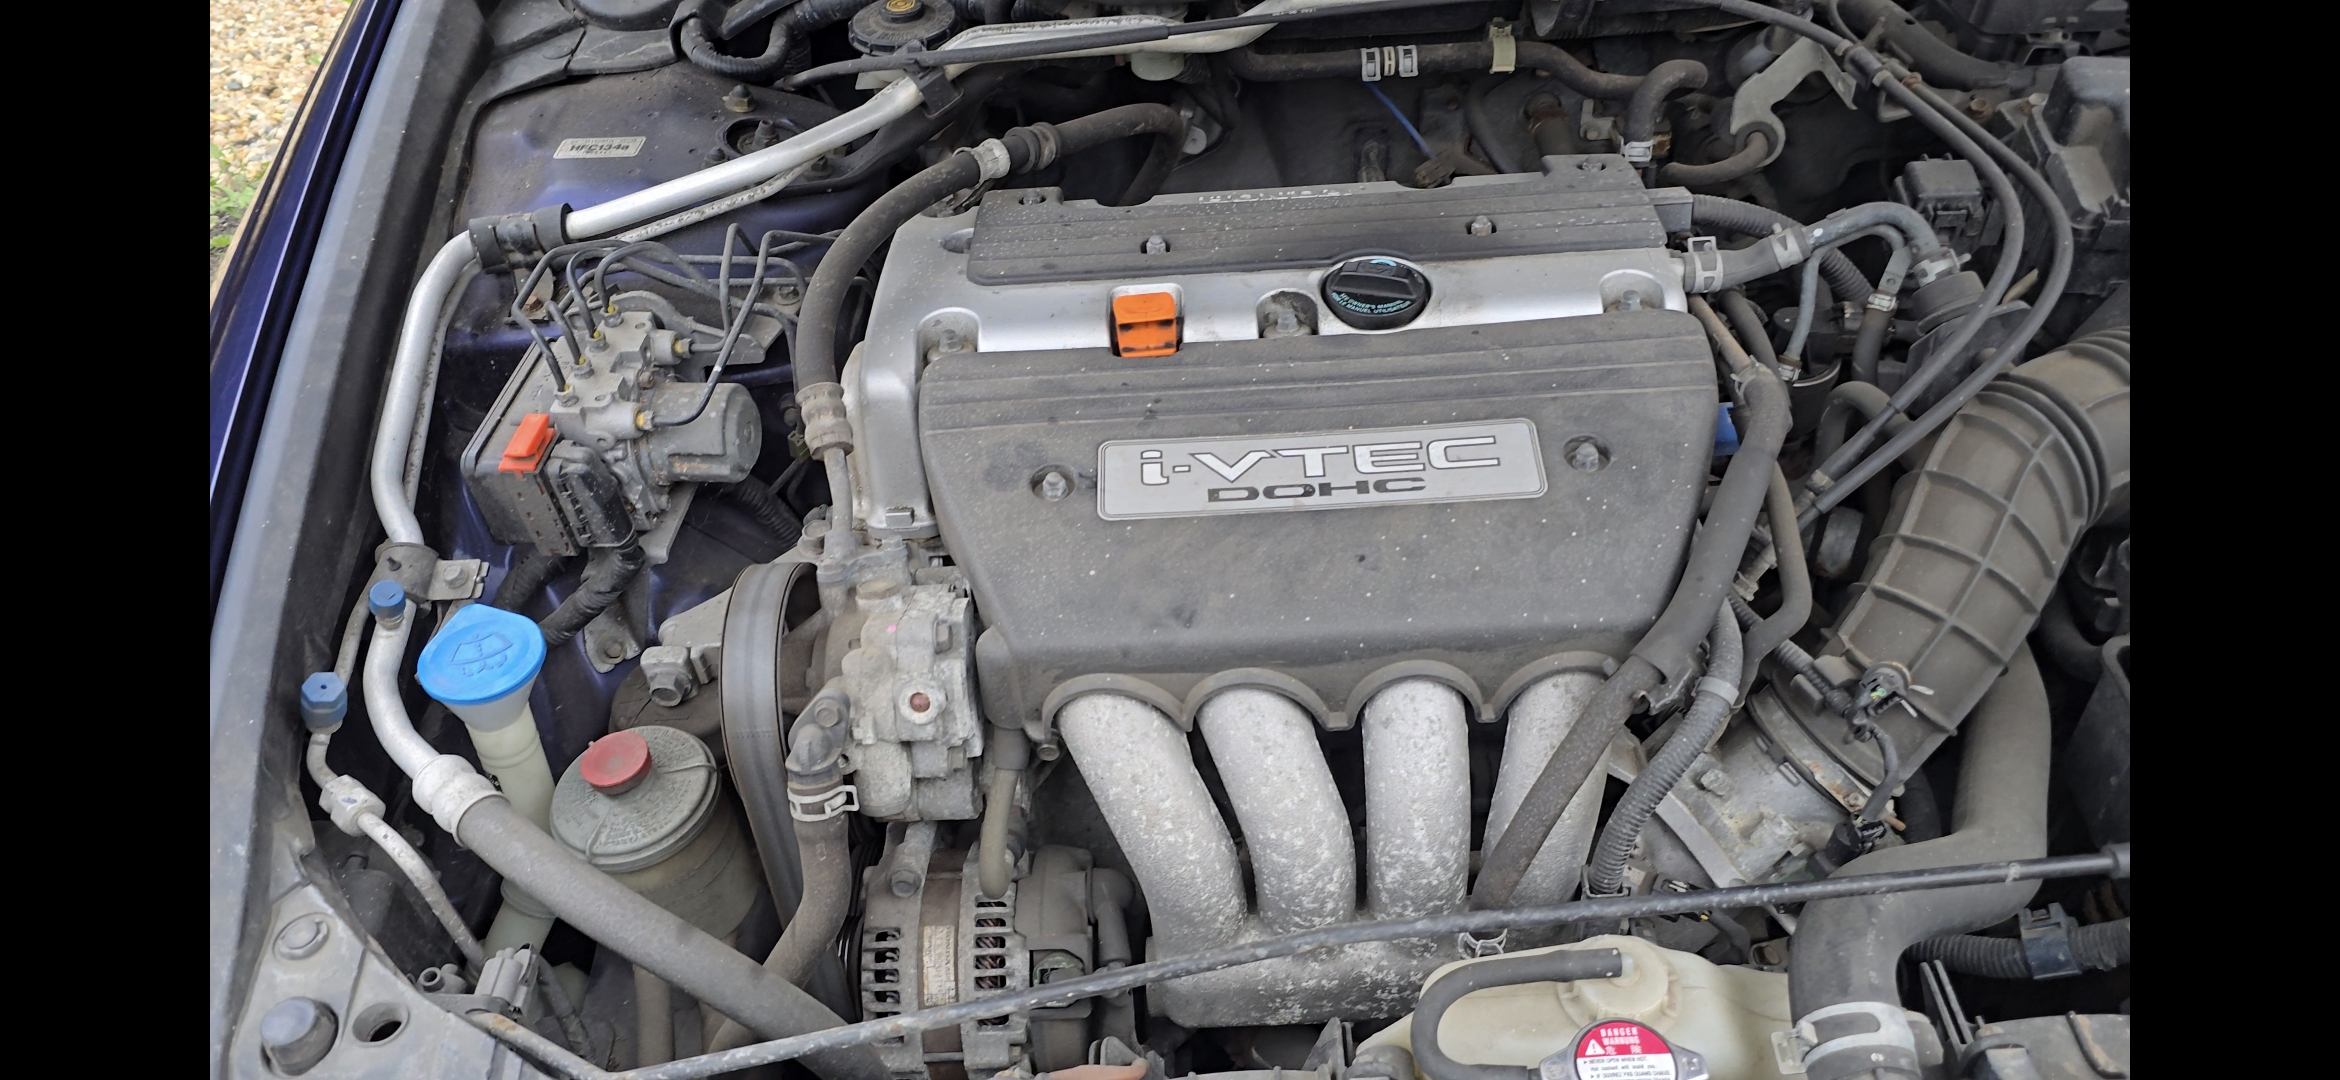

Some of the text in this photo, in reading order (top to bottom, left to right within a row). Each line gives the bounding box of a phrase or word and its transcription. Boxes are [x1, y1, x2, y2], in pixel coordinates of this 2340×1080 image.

[569, 143, 630, 152] HFC134a
[1346, 304, 1371, 313] MANUEL
[1140, 435, 1500, 487] i-VTEC
[1208, 476, 1426, 503] DOHC
[1600, 1027, 1637, 1037] DANGER
